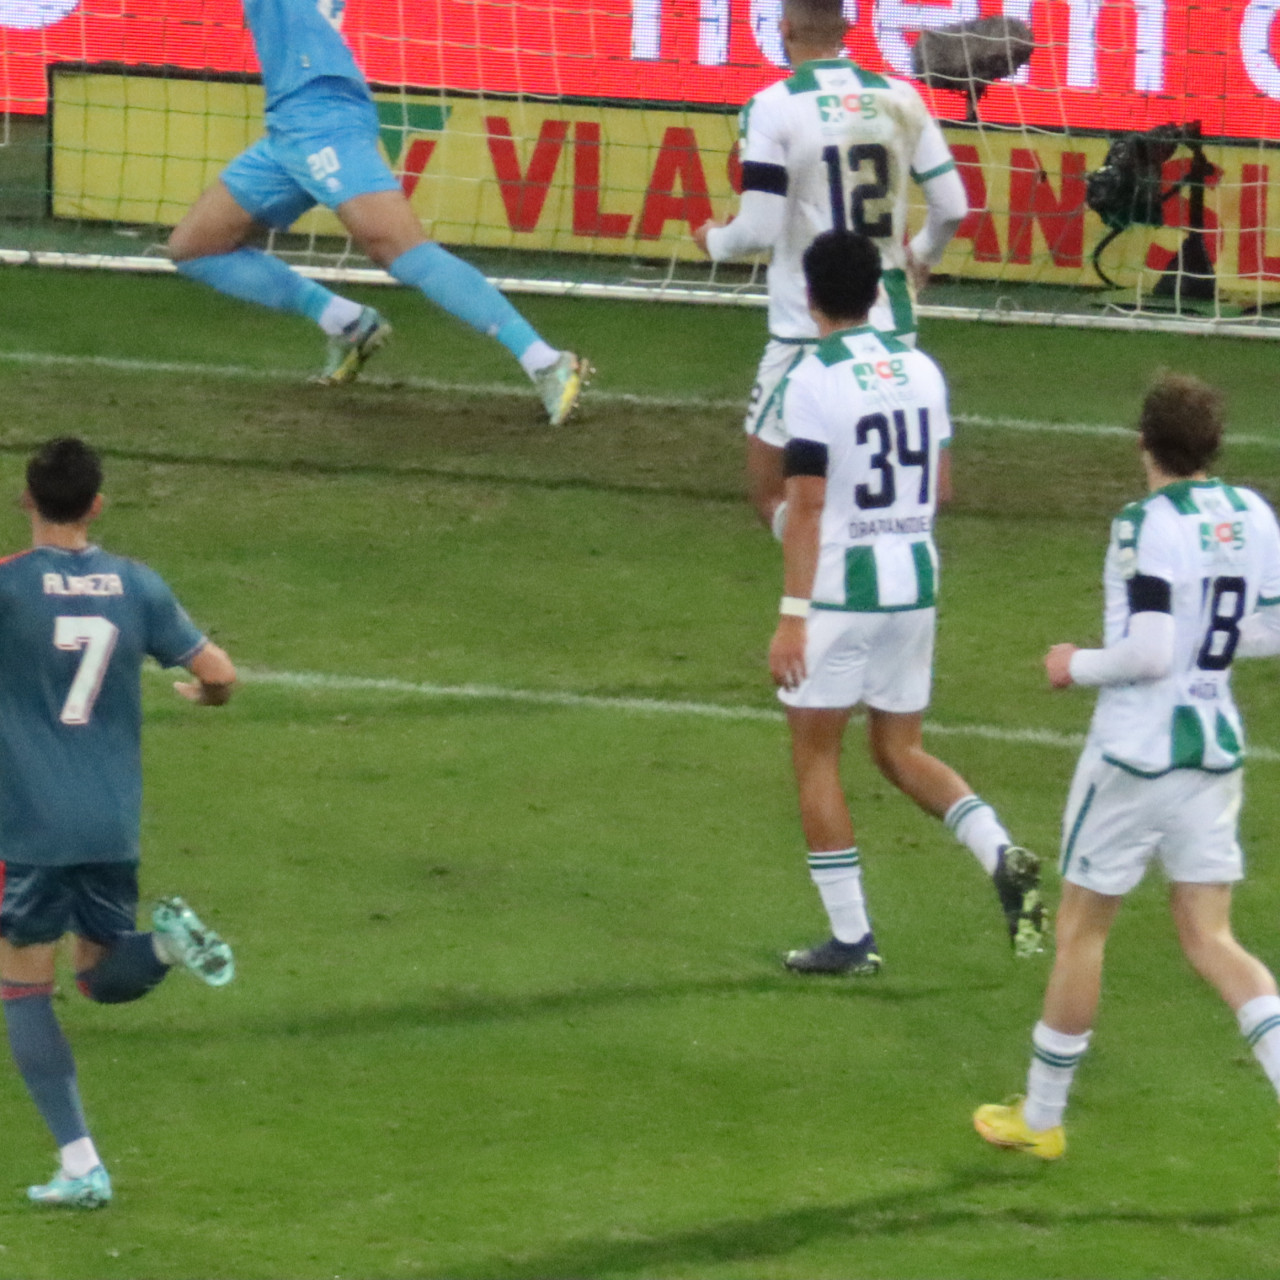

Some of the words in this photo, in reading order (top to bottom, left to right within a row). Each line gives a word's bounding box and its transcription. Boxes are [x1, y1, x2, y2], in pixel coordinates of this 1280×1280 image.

[822, 143, 894, 238] 12
[854, 407, 930, 510] 34
[53, 615, 120, 726] 7
